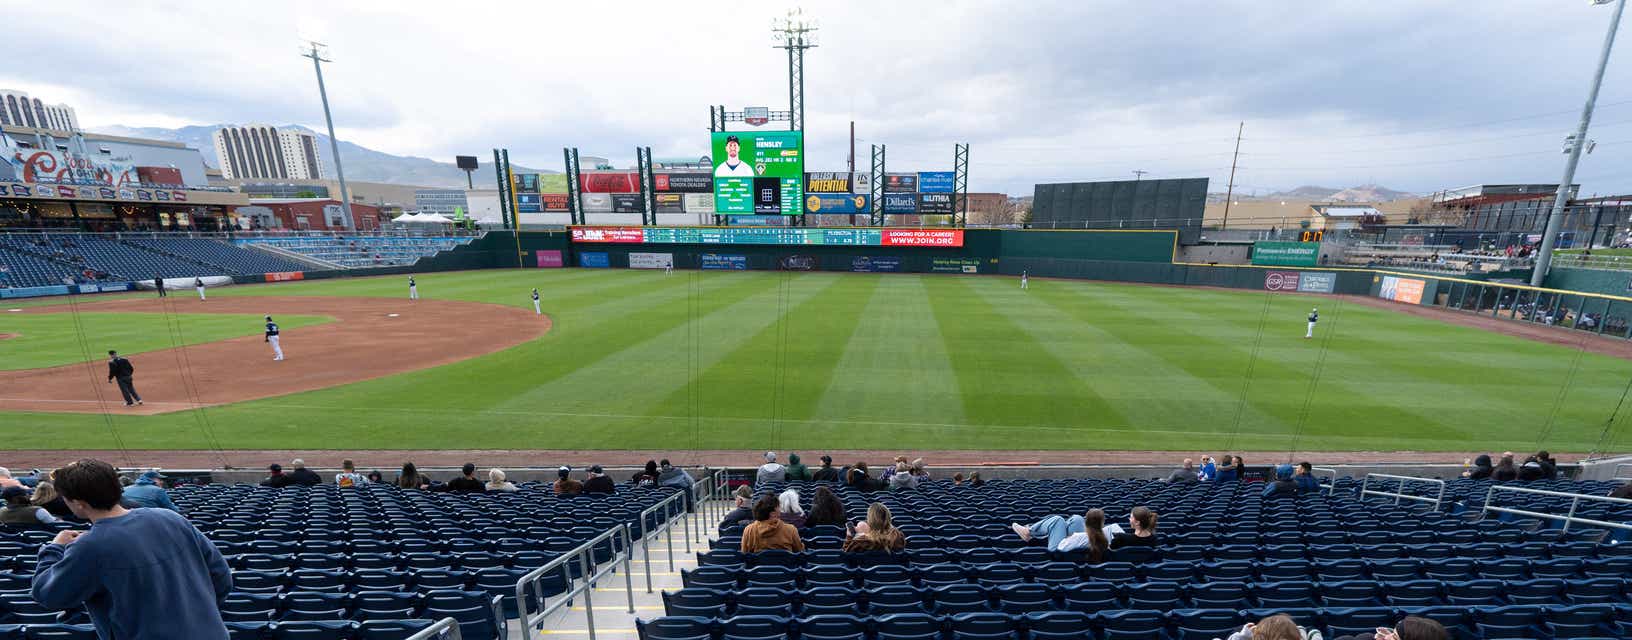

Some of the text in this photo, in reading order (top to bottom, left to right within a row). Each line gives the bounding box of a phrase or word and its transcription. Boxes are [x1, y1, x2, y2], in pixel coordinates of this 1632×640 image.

[808, 180, 848, 192] POTENTIAL
[886, 197, 916, 206] Dillard's
[1303, 231, 1323, 242] 0:17
[1269, 278, 1283, 286] GSR
